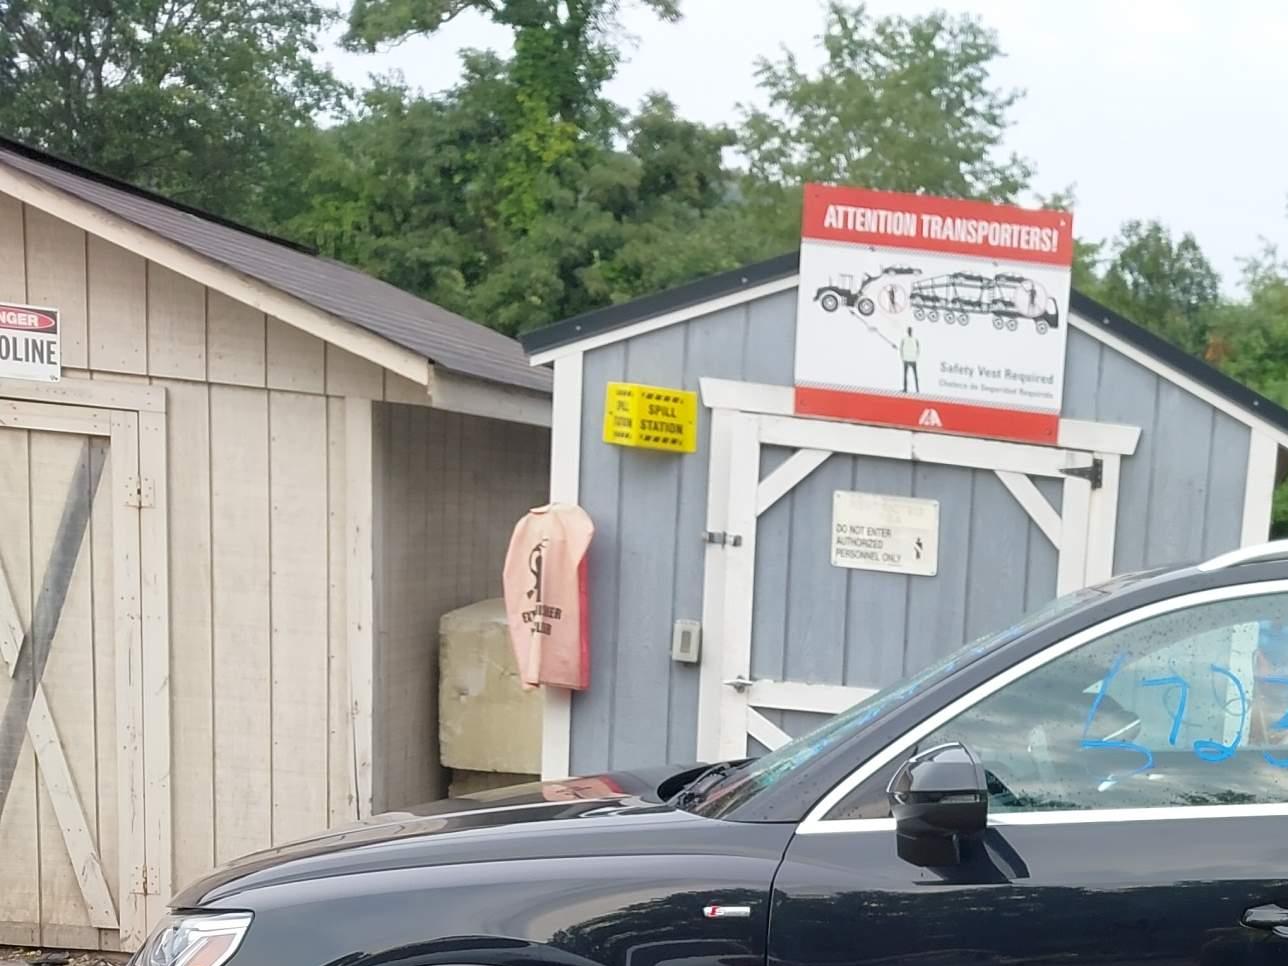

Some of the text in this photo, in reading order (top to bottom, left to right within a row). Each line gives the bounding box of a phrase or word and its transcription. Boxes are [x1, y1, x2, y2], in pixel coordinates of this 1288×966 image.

[824, 205, 1058, 252] ATTENTION TRANSPORTERS!
[940, 361, 1055, 385] Safety Vest Required
[648, 404, 676, 417] SPILL
[640, 420, 683, 434] STATION
[836, 523, 891, 537] DO NOT ENTER
[836, 537, 883, 549] AUTHORIZED
[836, 548, 901, 563] PERSONNEL ONLY
